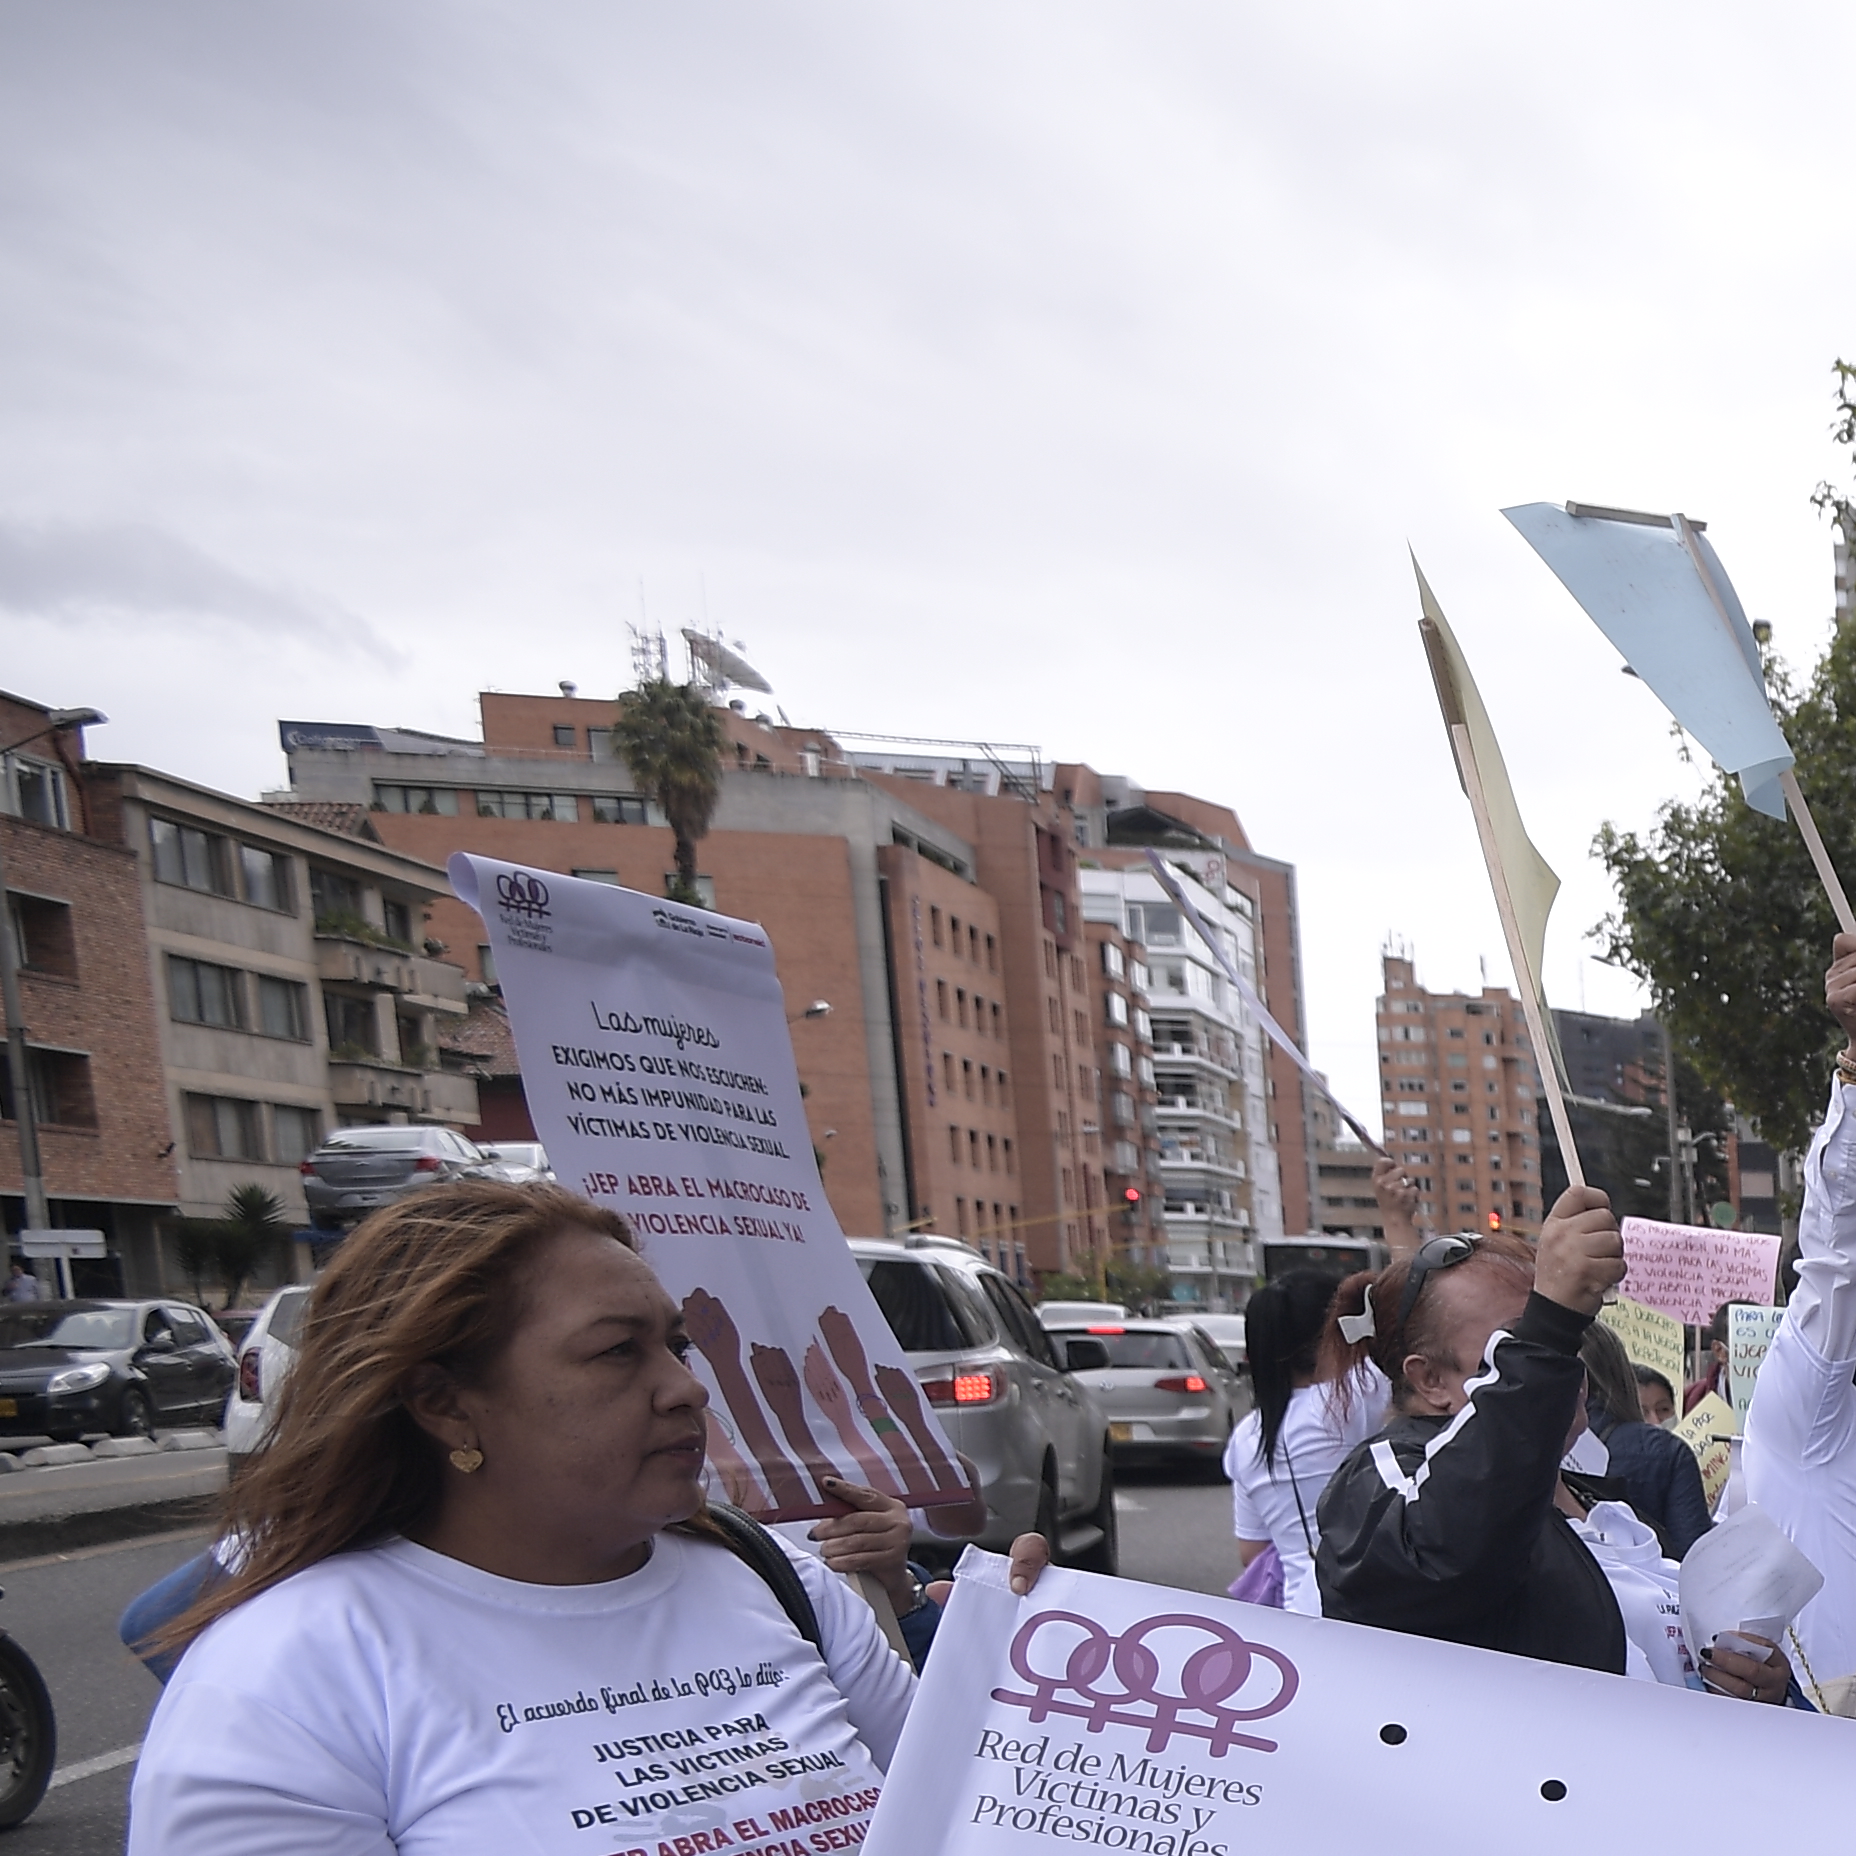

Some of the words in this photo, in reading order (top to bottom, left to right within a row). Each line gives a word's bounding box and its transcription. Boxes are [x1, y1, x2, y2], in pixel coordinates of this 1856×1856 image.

[591, 1001, 642, 1033] Las
[642, 1017, 720, 1051] mujeres
[552, 1044, 636, 1073] EXIGIMOS
[641, 1055, 674, 1078] QUE
[679, 1059, 705, 1081] NOS
[706, 1065, 768, 1096] ESCUCHEN:
[567, 1081, 596, 1102] NO
[600, 1082, 638, 1107] MÁS
[642, 1089, 724, 1116] IMPUNIDAD
[724, 1102, 754, 1121] PARA
[755, 1108, 777, 1126] LAS
[568, 1112, 651, 1141] VÍCTIMAS
[653, 1121, 677, 1142] DE
[680, 1124, 749, 1150] VIOLENCIA
[496, 1702, 520, 1733] El
[524, 1692, 599, 1723] acuerdo
[601, 1685, 648, 1714] final
[651, 1681, 673, 1704] de
[674, 1676, 695, 1696] la
[736, 1666, 752, 1688] lo
[592, 1729, 704, 1764] JUSTICIA
[707, 1712, 772, 1745] PARA
[615, 1763, 671, 1788] LAS
[673, 1735, 789, 1778] VICTIMAS
[571, 1804, 618, 1830] DE
[620, 1770, 768, 1818] VIOLENCIA
[765, 1749, 846, 1780] SEXUAL
[974, 1728, 1051, 1767] Red
[1053, 1740, 1102, 1777] de
[1107, 1751, 1263, 1806] Mujeres
[1011, 1763, 1182, 1825] Víctimas
[1187, 1806, 1215, 1834] y
